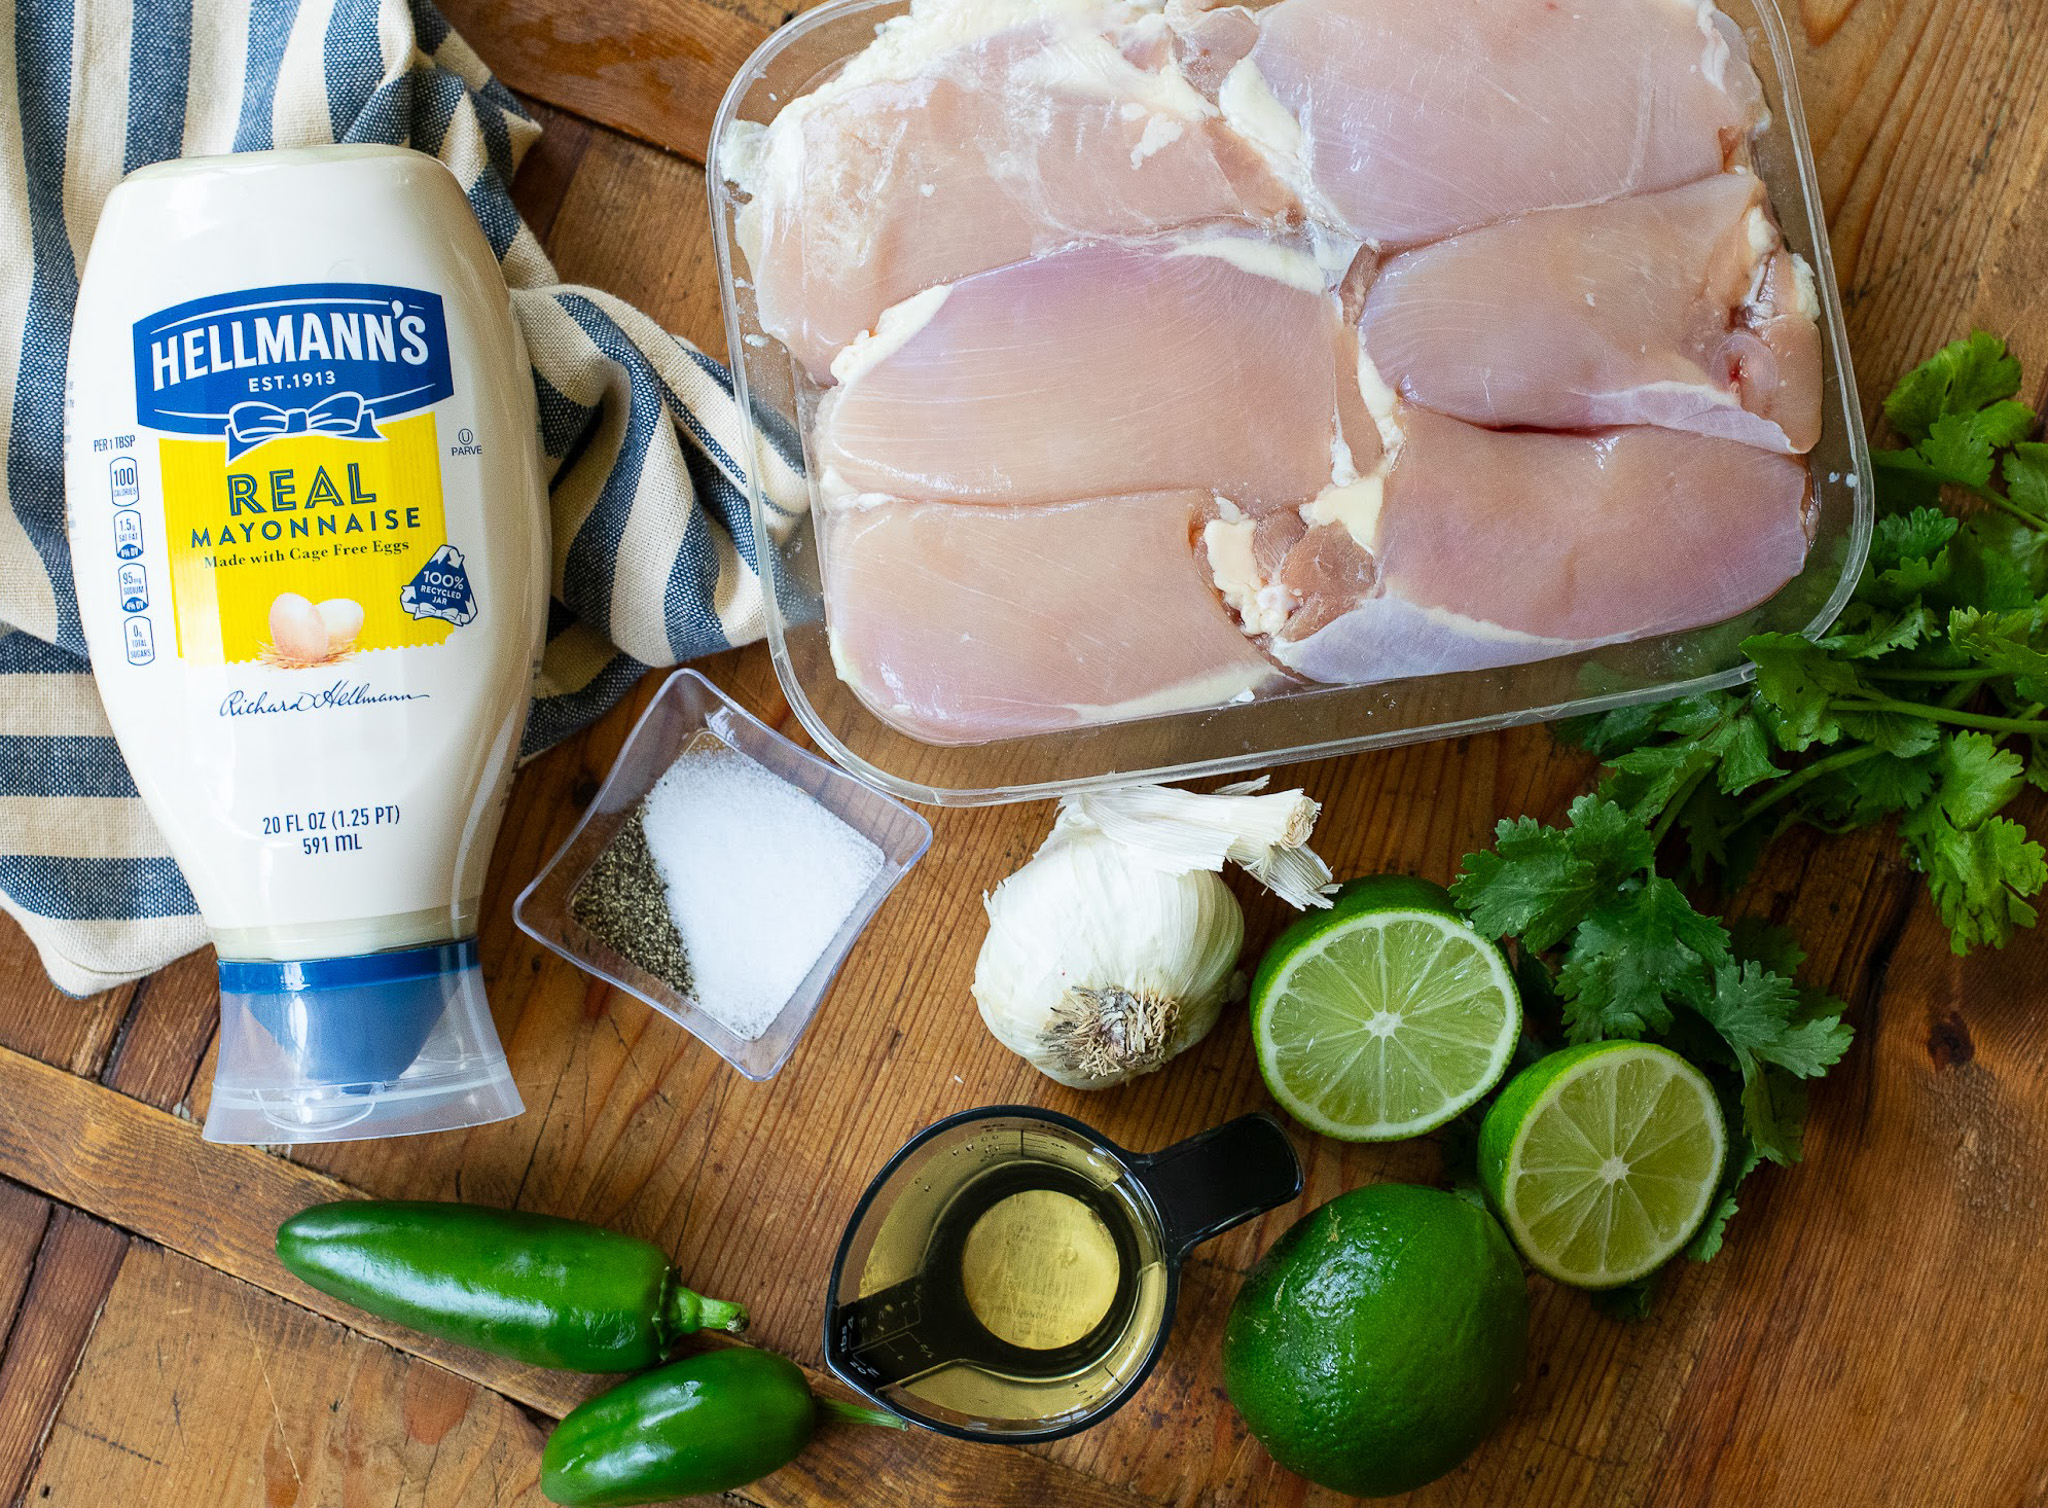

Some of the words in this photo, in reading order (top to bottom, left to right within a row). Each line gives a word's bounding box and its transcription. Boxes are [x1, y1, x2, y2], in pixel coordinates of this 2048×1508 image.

[151, 299, 429, 392] HELLMANN'S
[248, 370, 337, 393] EST.1913
[93, 438, 108, 453] PER
[109, 439, 113, 450] 1
[114, 434, 136, 449] TBSP
[451, 445, 483, 456] PARVE
[113, 467, 135, 487] 100
[113, 486, 137, 498] CALORIES
[227, 464, 377, 516] REAL
[128, 532, 139, 542] FAT
[191, 506, 421, 549] MAYONNAISE
[203, 553, 247, 569] Made
[250, 549, 285, 564] with
[289, 546, 329, 563] Cage
[333, 542, 369, 557] Free
[372, 539, 410, 556] Eggs
[423, 570, 465, 590] 100%
[123, 585, 144, 596] SODIUM
[420, 584, 462, 600] RECYCLED
[431, 596, 448, 605] JAR
[131, 639, 147, 648] TOTAL
[130, 648, 152, 660] SUGARS
[312, 679, 431, 709] Hellmann
[262, 816, 281, 835] 20
[286, 814, 304, 833] FL
[308, 811, 327, 831] OZ
[331, 807, 370, 831] (1.25
[374, 804, 401, 825] PT)
[302, 835, 330, 855] 591
[335, 833, 363, 852] mL
